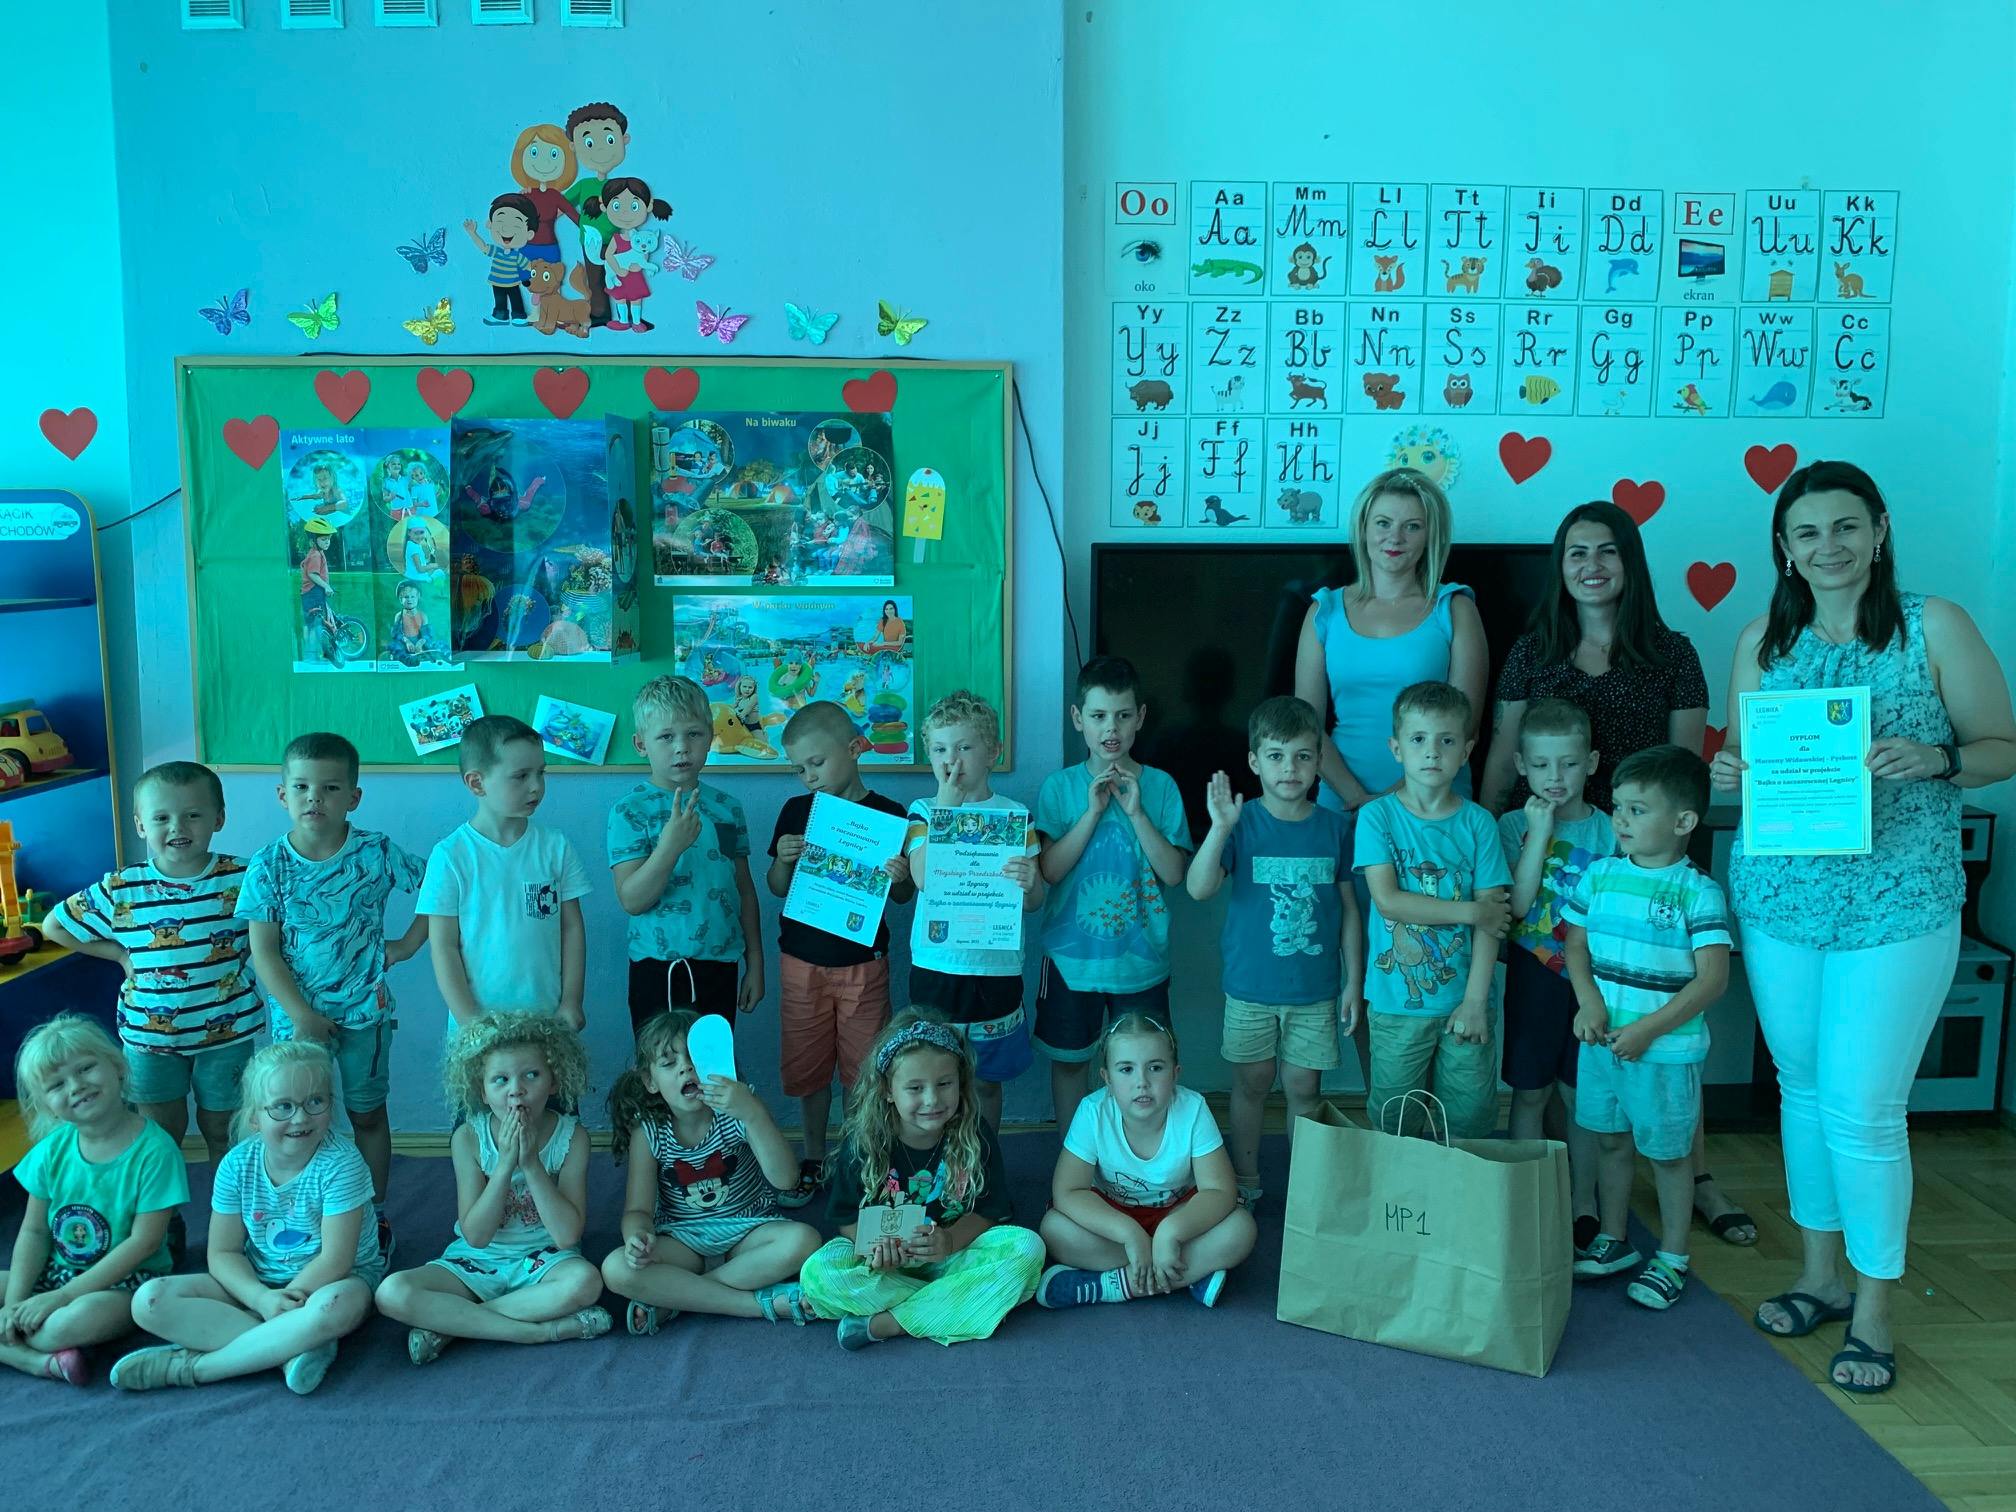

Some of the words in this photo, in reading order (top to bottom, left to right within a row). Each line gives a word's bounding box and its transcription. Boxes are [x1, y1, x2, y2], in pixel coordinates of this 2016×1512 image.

[1134, 281, 1156, 292] oko
[1683, 289, 1715, 301] ekran
[745, 417, 758, 428] Na
[761, 417, 797, 428] biwaku
[291, 433, 330, 446] Aktywne
[332, 432, 355, 445] lato
[1385, 1202, 1431, 1236] MP1
